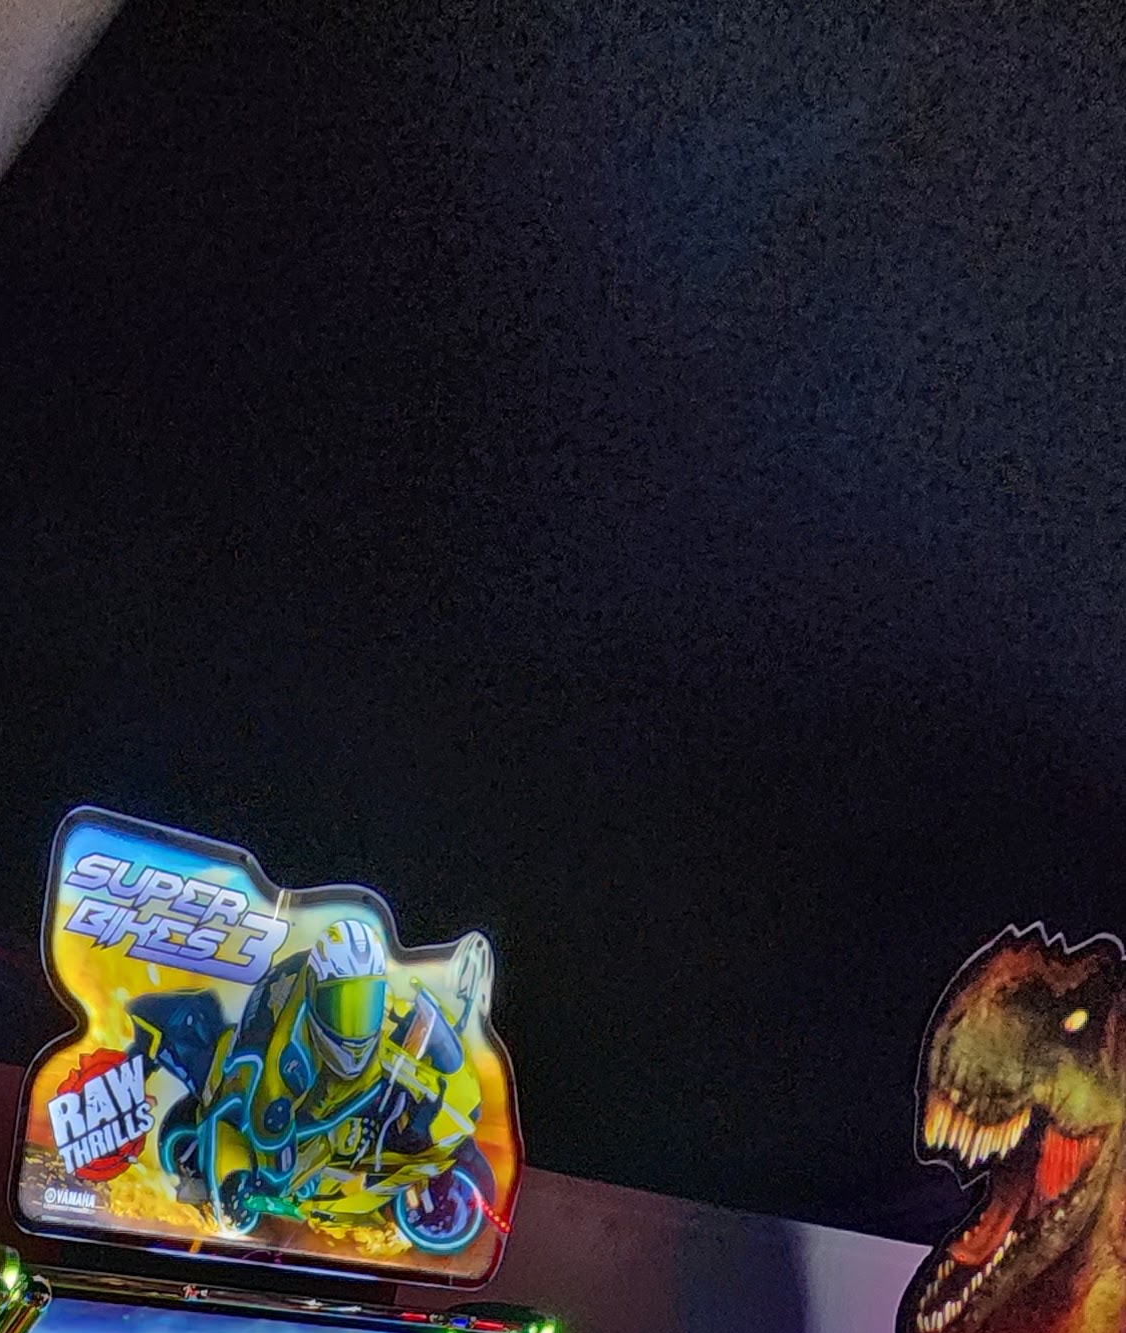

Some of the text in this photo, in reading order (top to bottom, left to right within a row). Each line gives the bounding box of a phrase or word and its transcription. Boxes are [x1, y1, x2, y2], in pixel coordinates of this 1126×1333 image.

[64, 852, 250, 926] SUPER
[64, 896, 290, 985] BIKES 3
[47, 1054, 145, 1147] RAW
[58, 1102, 155, 1174] THRILLS
[56, 1187, 97, 1208] YAMAHA
